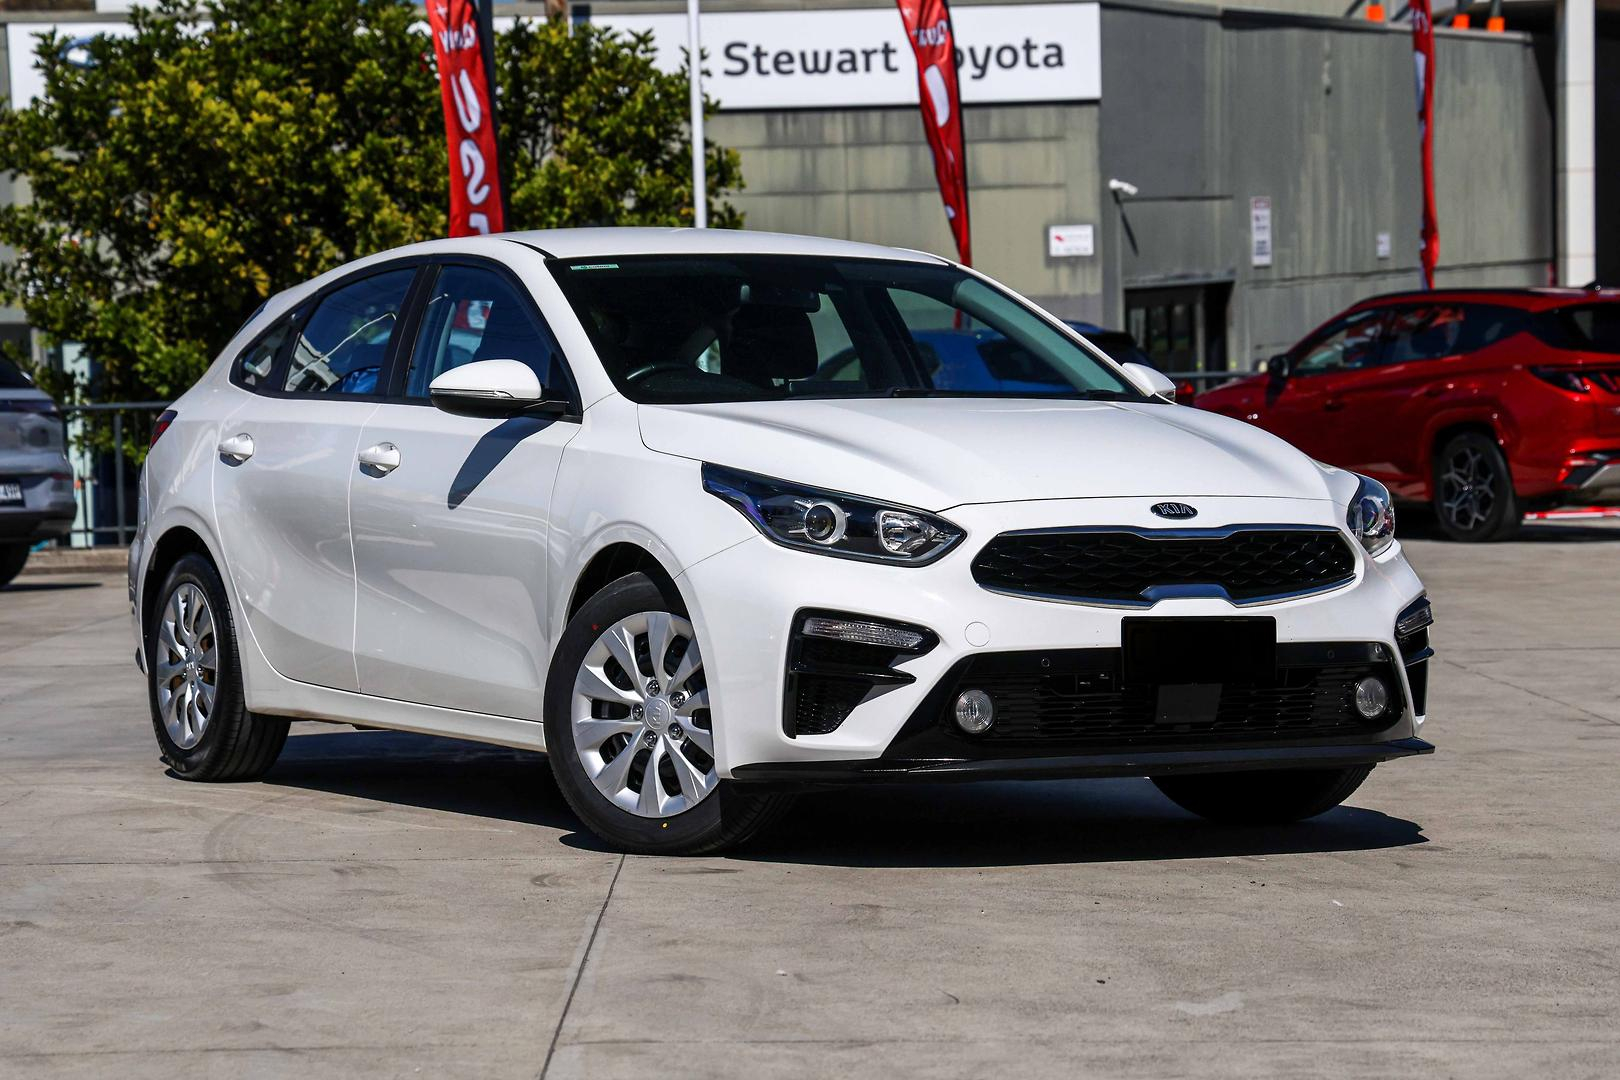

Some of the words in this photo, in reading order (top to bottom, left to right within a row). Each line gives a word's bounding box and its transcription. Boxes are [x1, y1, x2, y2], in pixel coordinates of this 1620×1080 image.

[724, 41, 899, 77] Stewart
[954, 38, 1065, 80] yota
[1156, 502, 1194, 515] KIA
